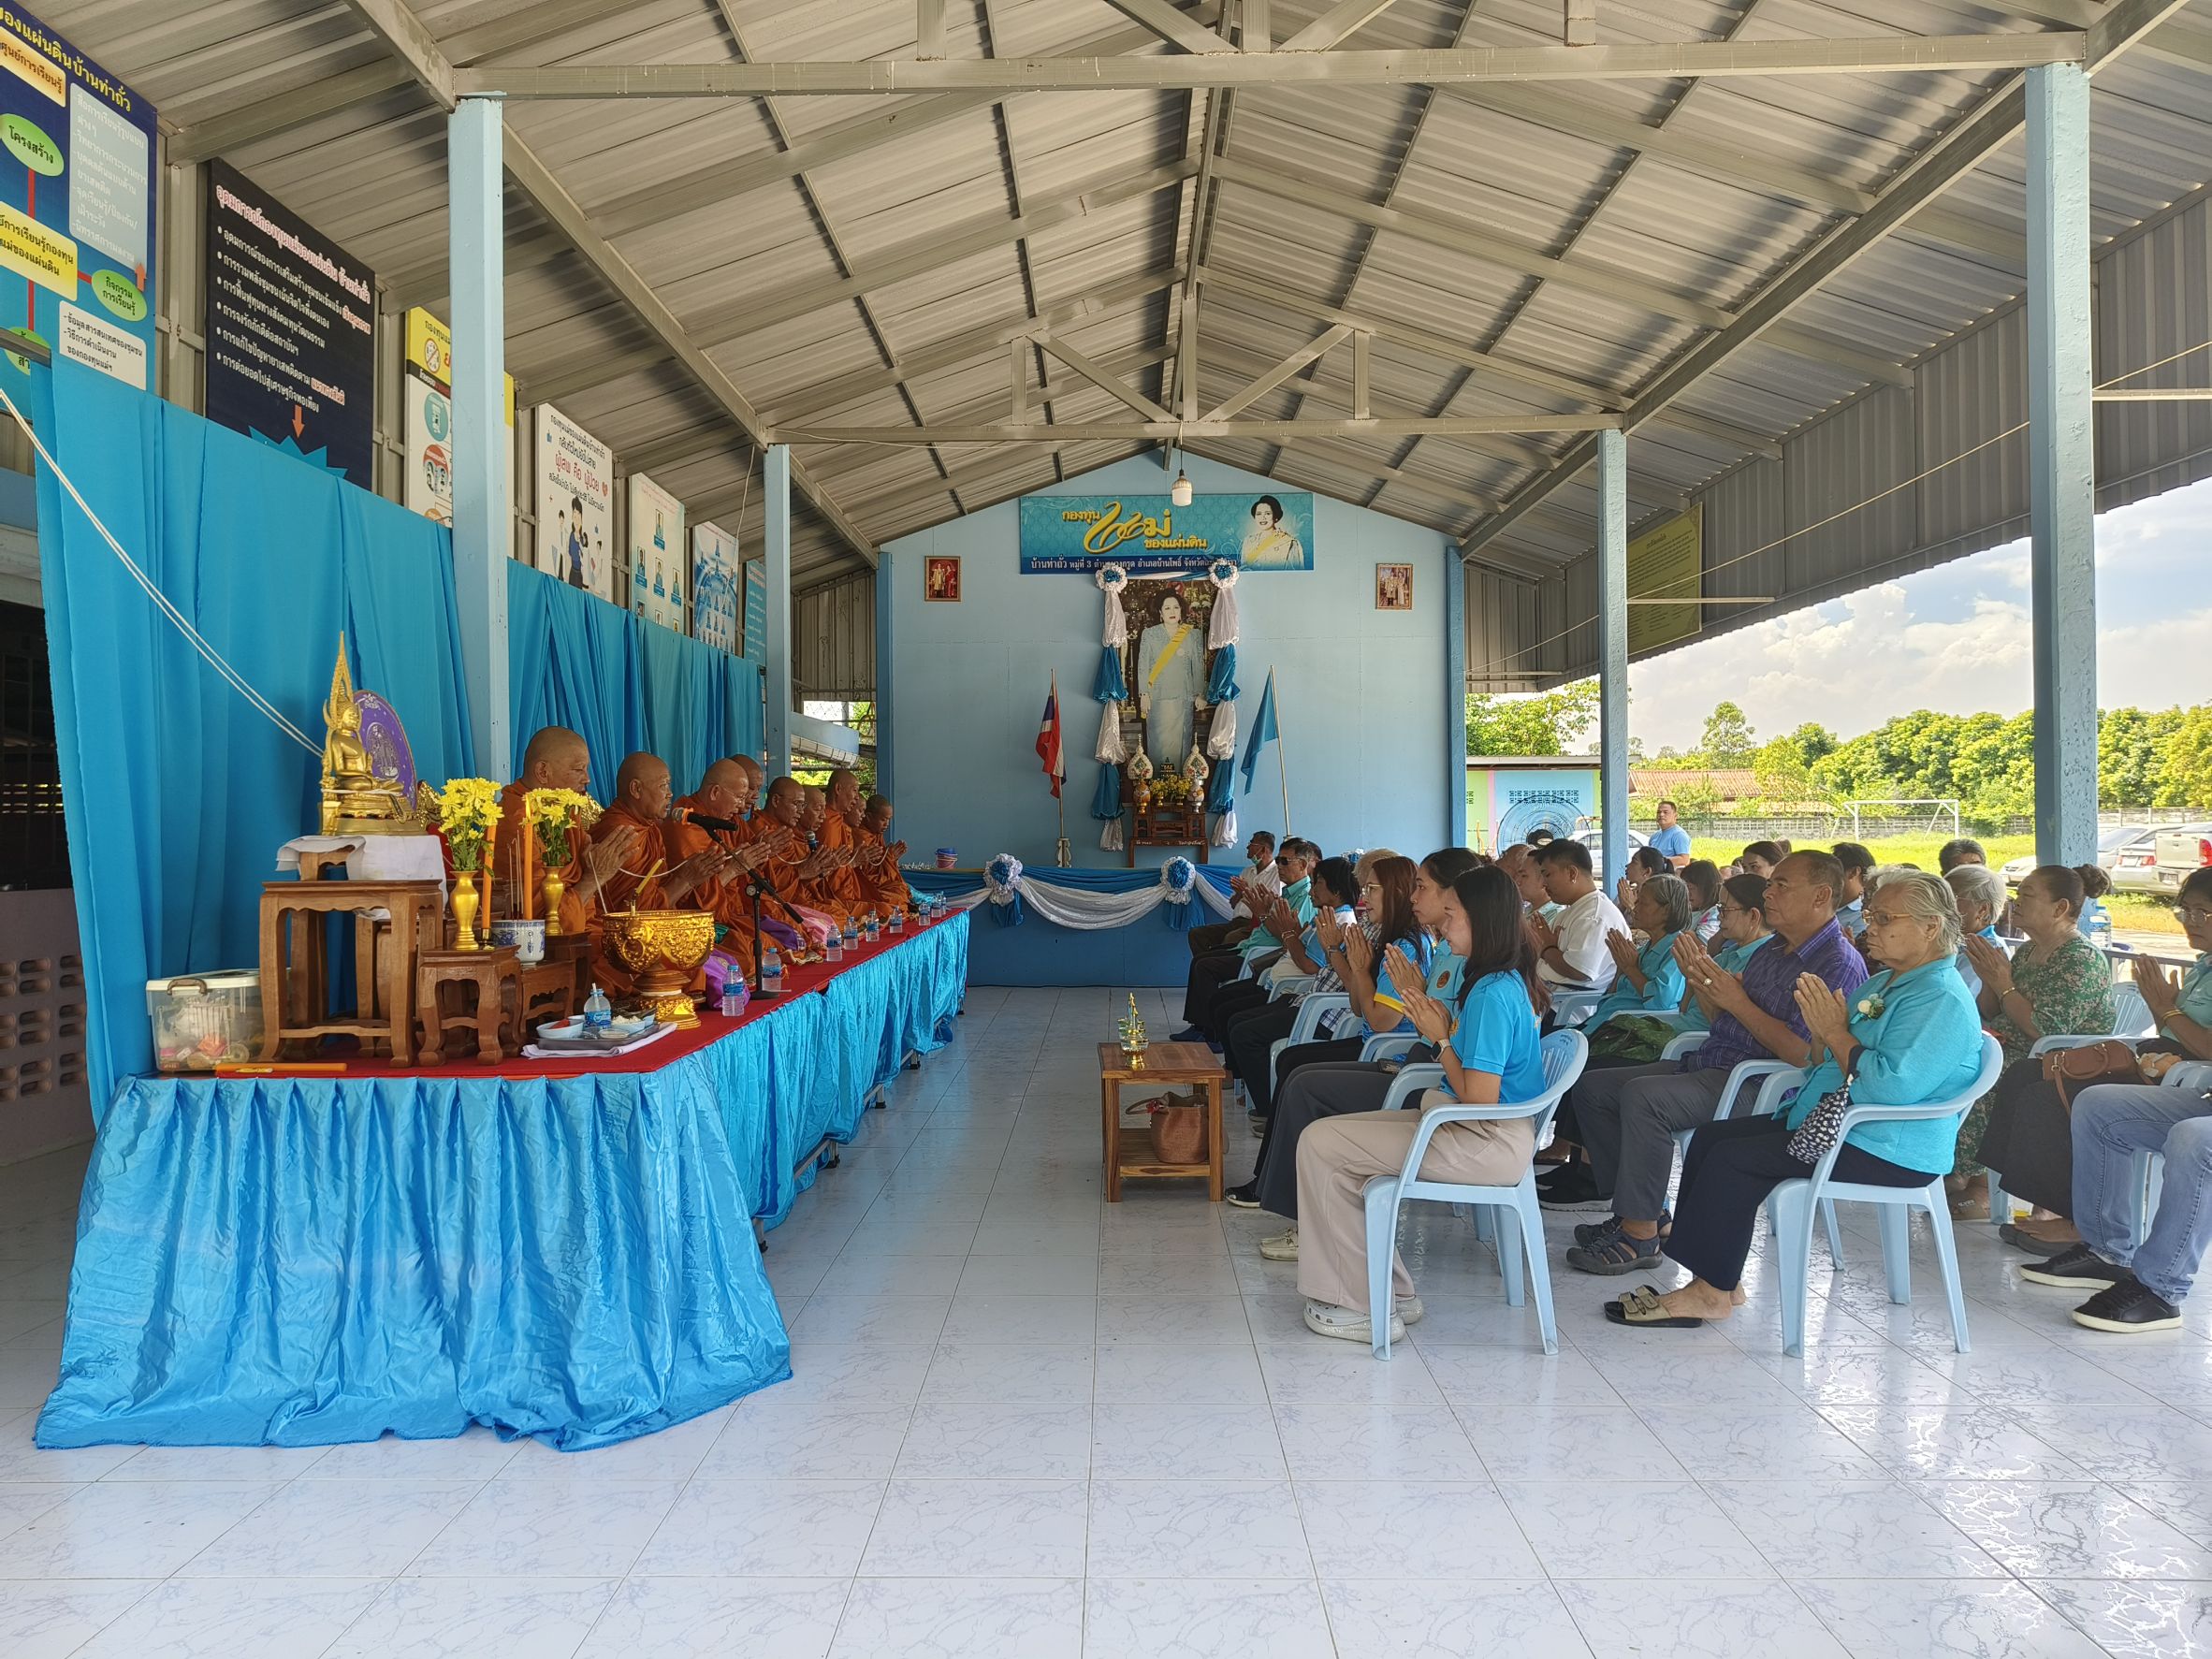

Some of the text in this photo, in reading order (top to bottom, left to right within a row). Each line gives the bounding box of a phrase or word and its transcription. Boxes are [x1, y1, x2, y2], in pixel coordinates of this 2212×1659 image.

[8, 124, 54, 164] โครงสร้าง
[106, 276, 133, 299] กิจกรรม
[102, 289, 137, 315] การเรียนรู้
[1062, 510, 1101, 525] กองทุน
[1143, 534, 1208, 550] ของแผ่นดิน
[1031, 554, 1068, 569] บ้านท่าถั่ว
[1070, 557, 1084, 571] หมู่ที่
[1138, 555, 1183, 568] อำเภอบ้านโพธิ์
